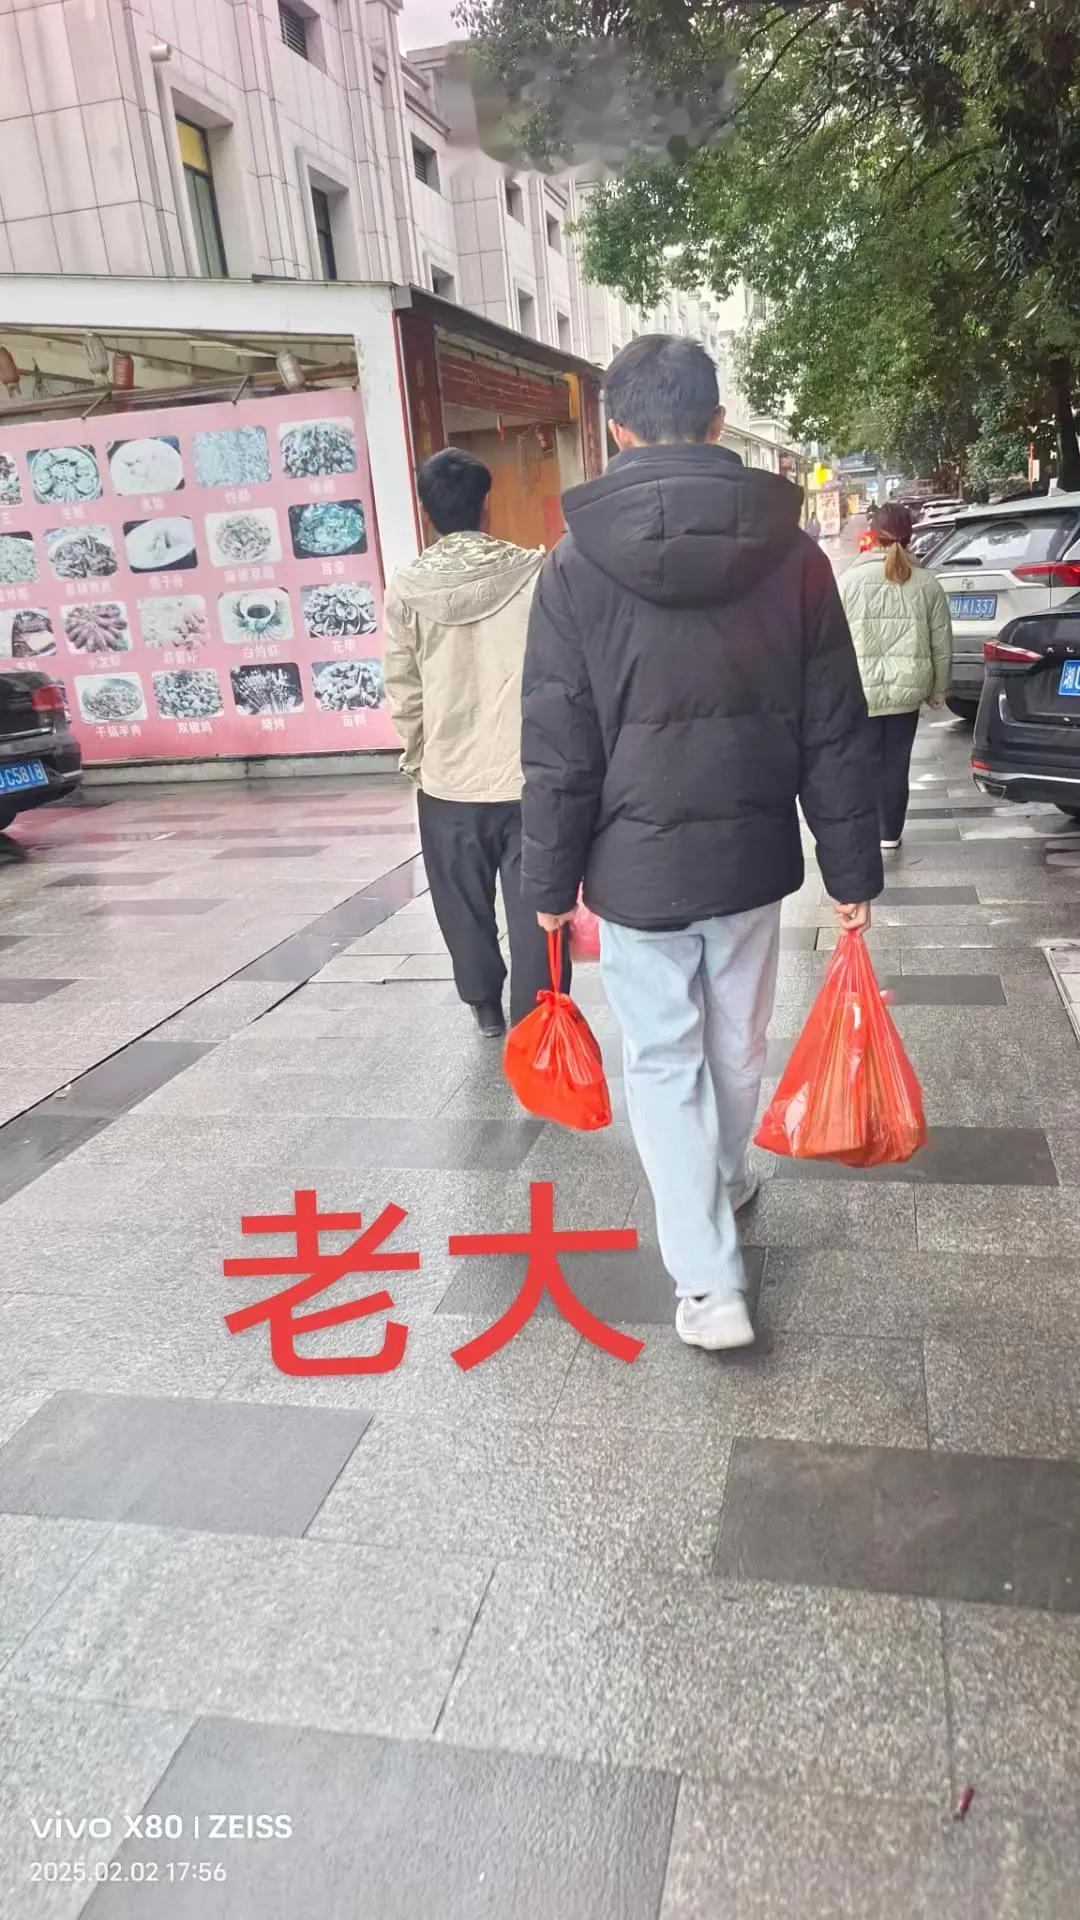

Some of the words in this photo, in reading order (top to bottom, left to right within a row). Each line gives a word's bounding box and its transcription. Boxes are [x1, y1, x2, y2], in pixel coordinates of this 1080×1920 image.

[242, 644, 279, 660] 白灼虾
[331, 639, 357, 654] 花甲
[95, 724, 142, 738] 干锅羊肉
[176, 720, 213, 735] 双椒鸡
[261, 717, 286, 732] 烧烤
